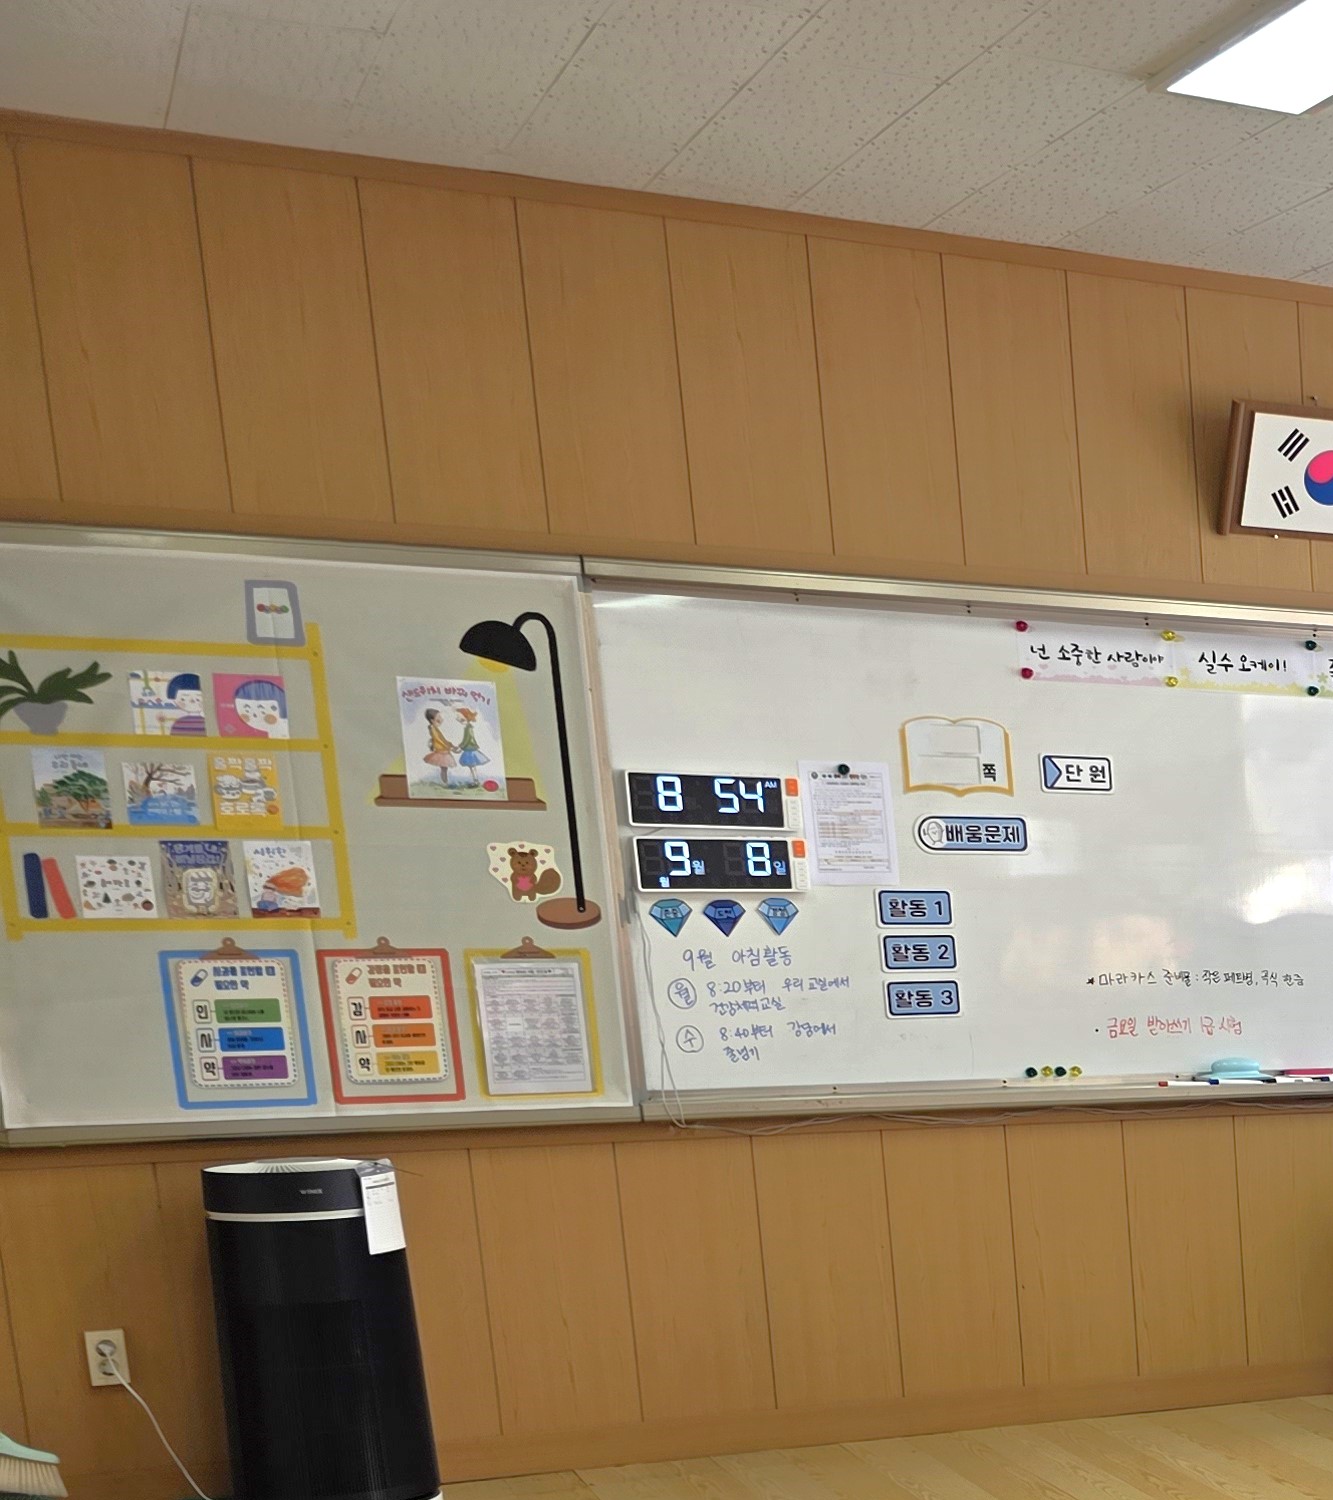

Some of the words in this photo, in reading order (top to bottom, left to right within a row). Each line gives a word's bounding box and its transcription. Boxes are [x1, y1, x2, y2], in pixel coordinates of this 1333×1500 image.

[1030, 644, 1050, 660] 넌
[1057, 643, 1102, 666] 소중한
[1199, 650, 1234, 674] 실수
[1239, 654, 1287, 672] 오케이!
[982, 763, 996, 782] 쪽
[656, 775, 684, 812] 8
[714, 777, 765, 814] 54
[764, 780, 778, 789] AM
[945, 825, 1019, 844] 배움문제
[889, 899, 927, 918] 활동
[934, 901, 943, 915] 1
[683, 949, 716, 971] 9월
[732, 946, 792, 967] 아침활동
[892, 944, 930, 962] 활동
[938, 945, 950, 960] 2
[782, 978, 803, 992] 우리
[808, 976, 849, 992] 교실에서
[1099, 972, 1158, 986] 마라카스
[1202, 969, 1220, 985] 작은
[1261, 970, 1278, 987] 곡식
[895, 990, 932, 1008] 활동
[940, 989, 953, 1005] 3
[196, 1005, 208, 1019] 인
[351, 1002, 362, 1017] 감
[787, 1021, 836, 1038] 강당에서
[1107, 1018, 1138, 1039] 금요일
[1147, 1016, 1191, 1035] 받아쓰기
[1219, 1016, 1243, 1035] 시험
[201, 1034, 212, 1048] 사
[355, 1030, 367, 1044] 사
[204, 1062, 216, 1076] 약
[359, 1058, 371, 1071] 약
